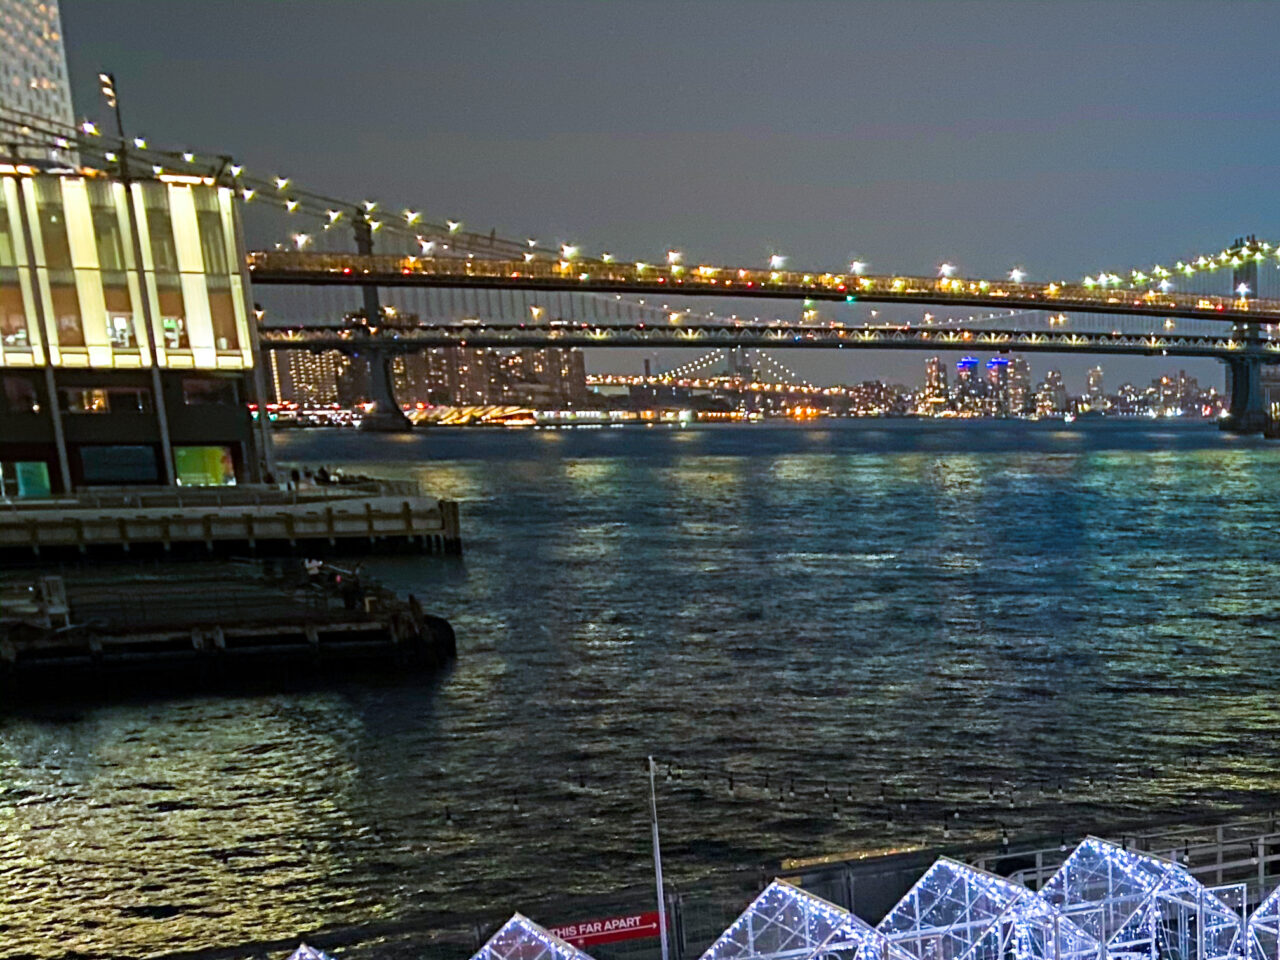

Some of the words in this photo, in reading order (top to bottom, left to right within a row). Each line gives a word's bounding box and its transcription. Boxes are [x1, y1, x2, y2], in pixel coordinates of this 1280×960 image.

[550, 926, 577, 938] THIS
[579, 921, 602, 934] FAR
[604, 916, 642, 931] APART
